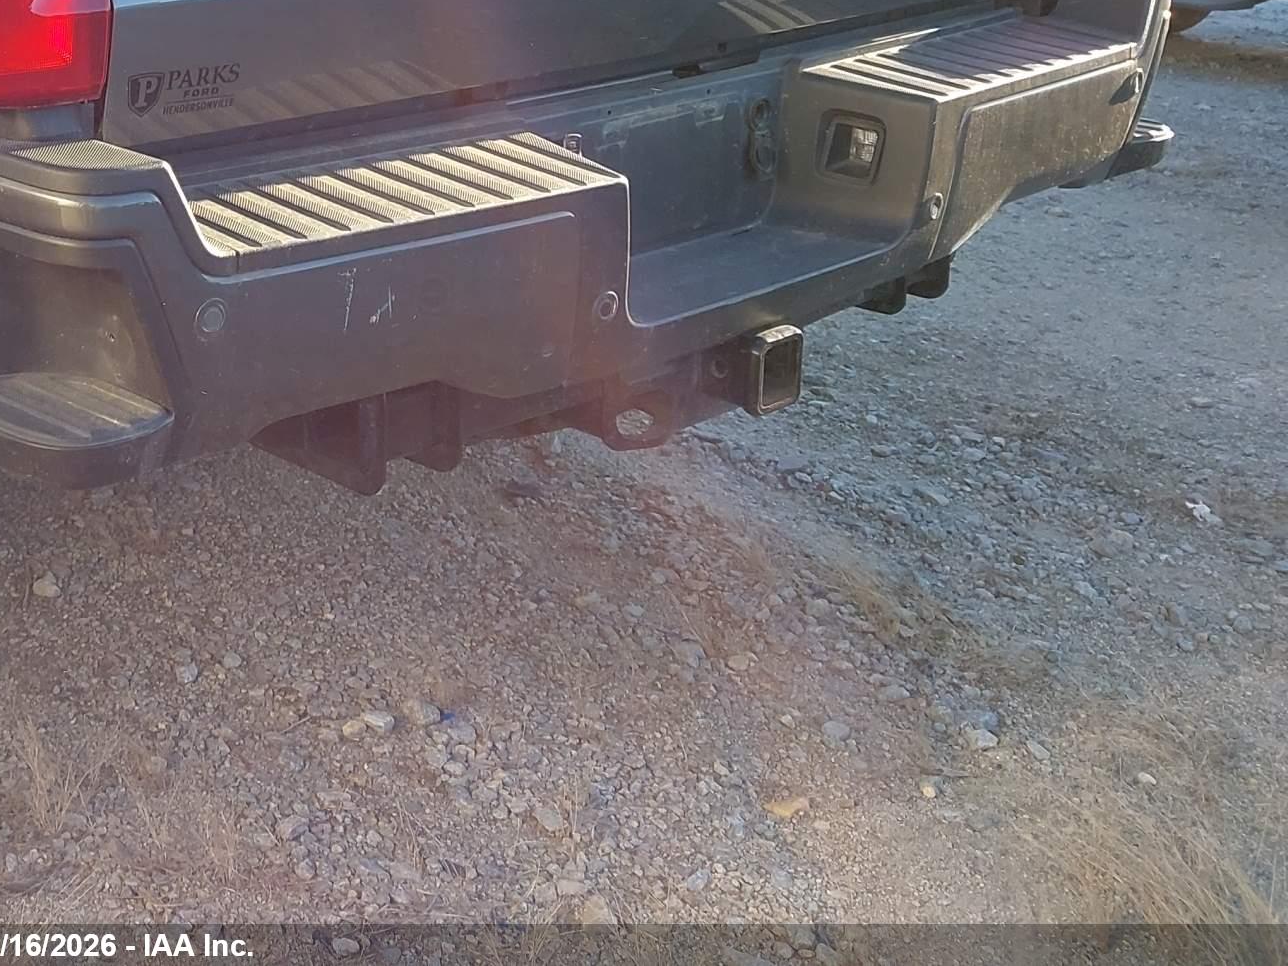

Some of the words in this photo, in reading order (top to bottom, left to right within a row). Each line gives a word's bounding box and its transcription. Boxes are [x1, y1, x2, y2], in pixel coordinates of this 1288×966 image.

[166, 62, 241, 90] PARKS
[183, 86, 220, 98] FORD
[162, 97, 235, 115] HENDERSONVILLE
